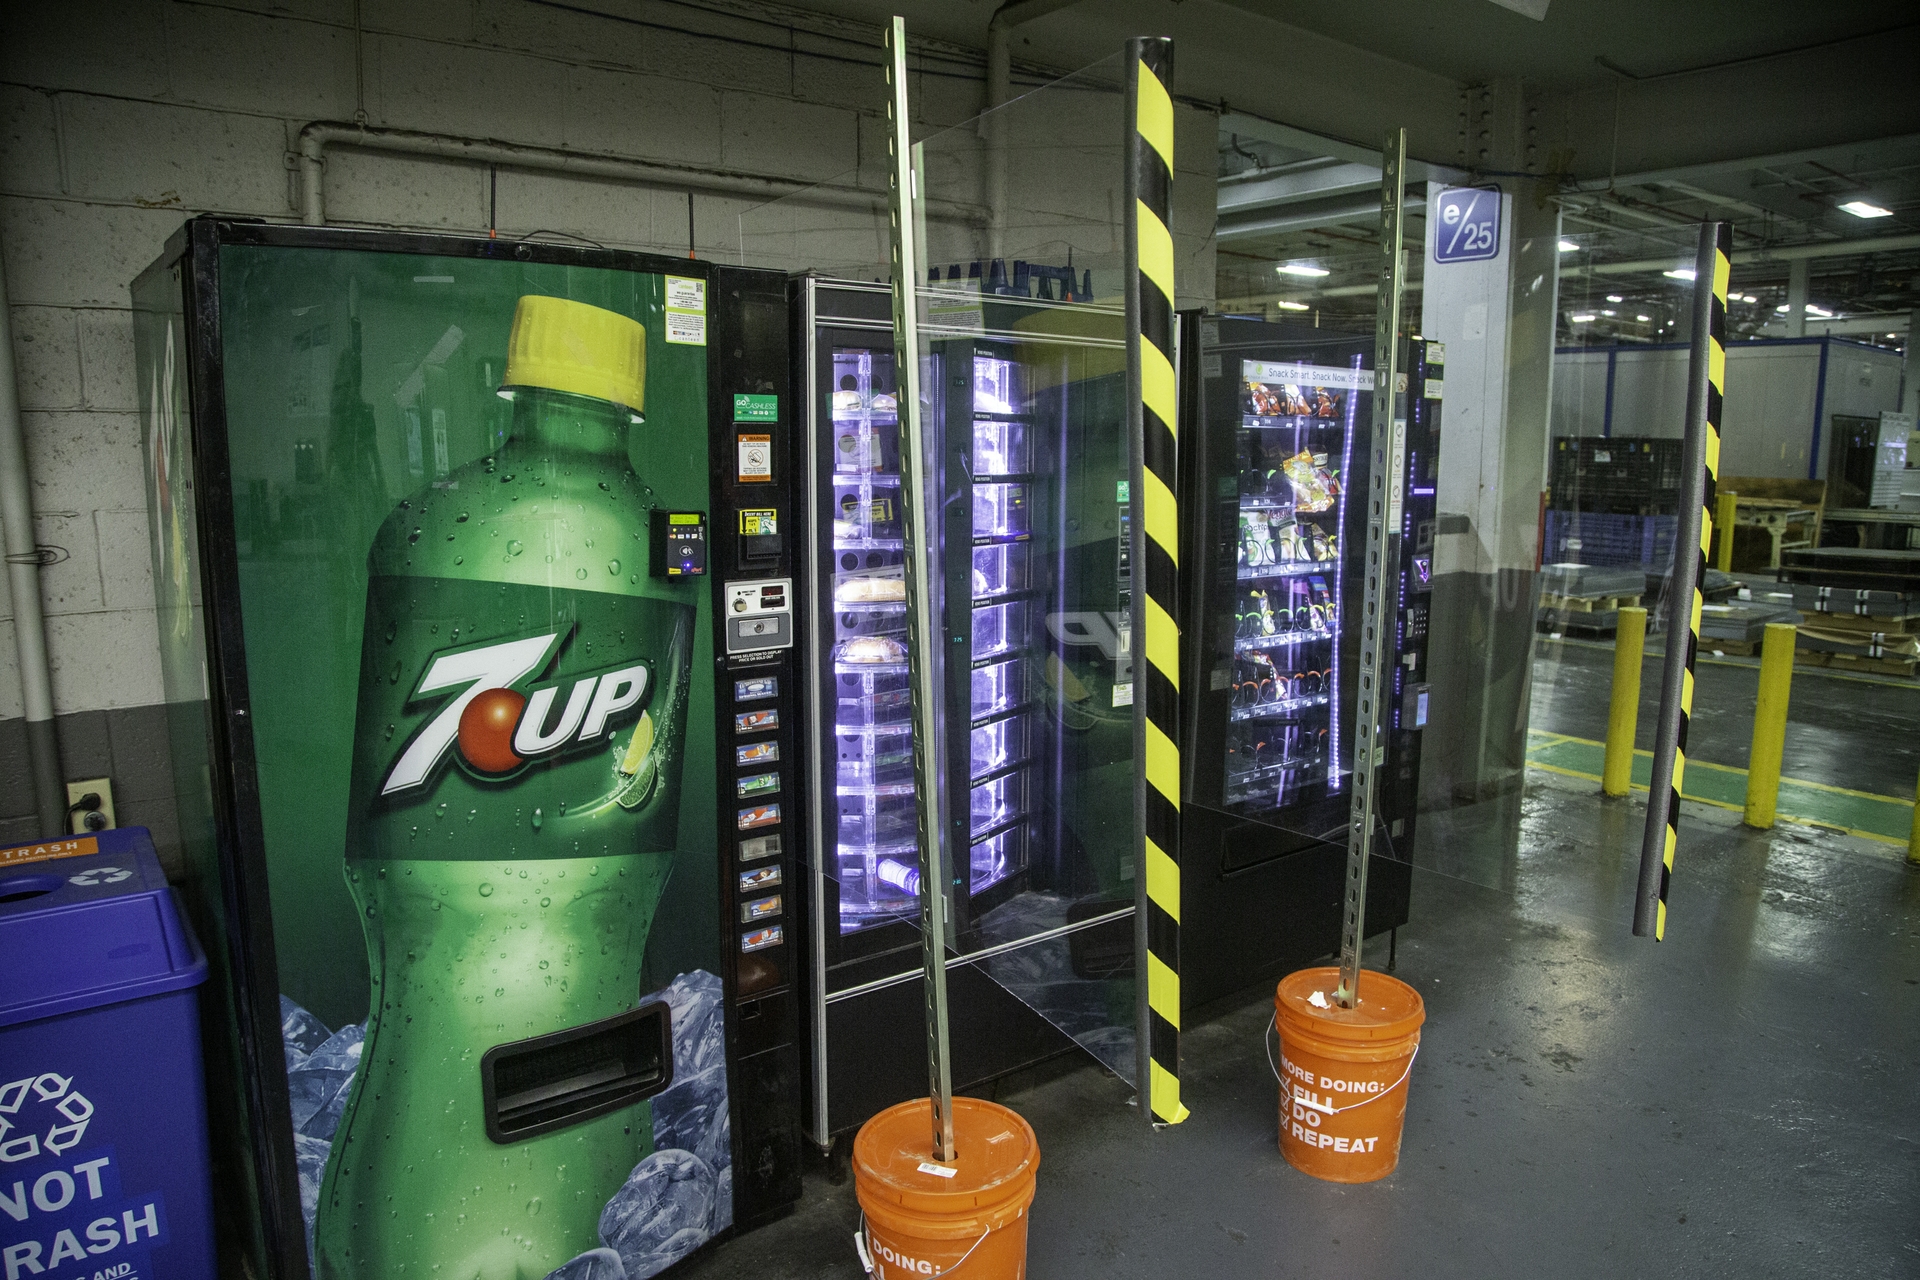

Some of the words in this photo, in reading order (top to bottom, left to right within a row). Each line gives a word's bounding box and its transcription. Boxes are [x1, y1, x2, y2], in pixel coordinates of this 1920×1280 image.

[1269, 368, 1289, 378] Snack
[1312, 371, 1331, 381] Snack
[1333, 373, 1347, 382] Now.
[381, 632, 648, 795] 7UP
[3, 842, 78, 859] TRASH
[1281, 1056, 1314, 1084] MORE
[1320, 1076, 1385, 1093] DOING:
[1293, 1103, 1321, 1127] DO
[1292, 1122, 1378, 1153] REPEAT
[873, 1237, 941, 1276] DOING:
